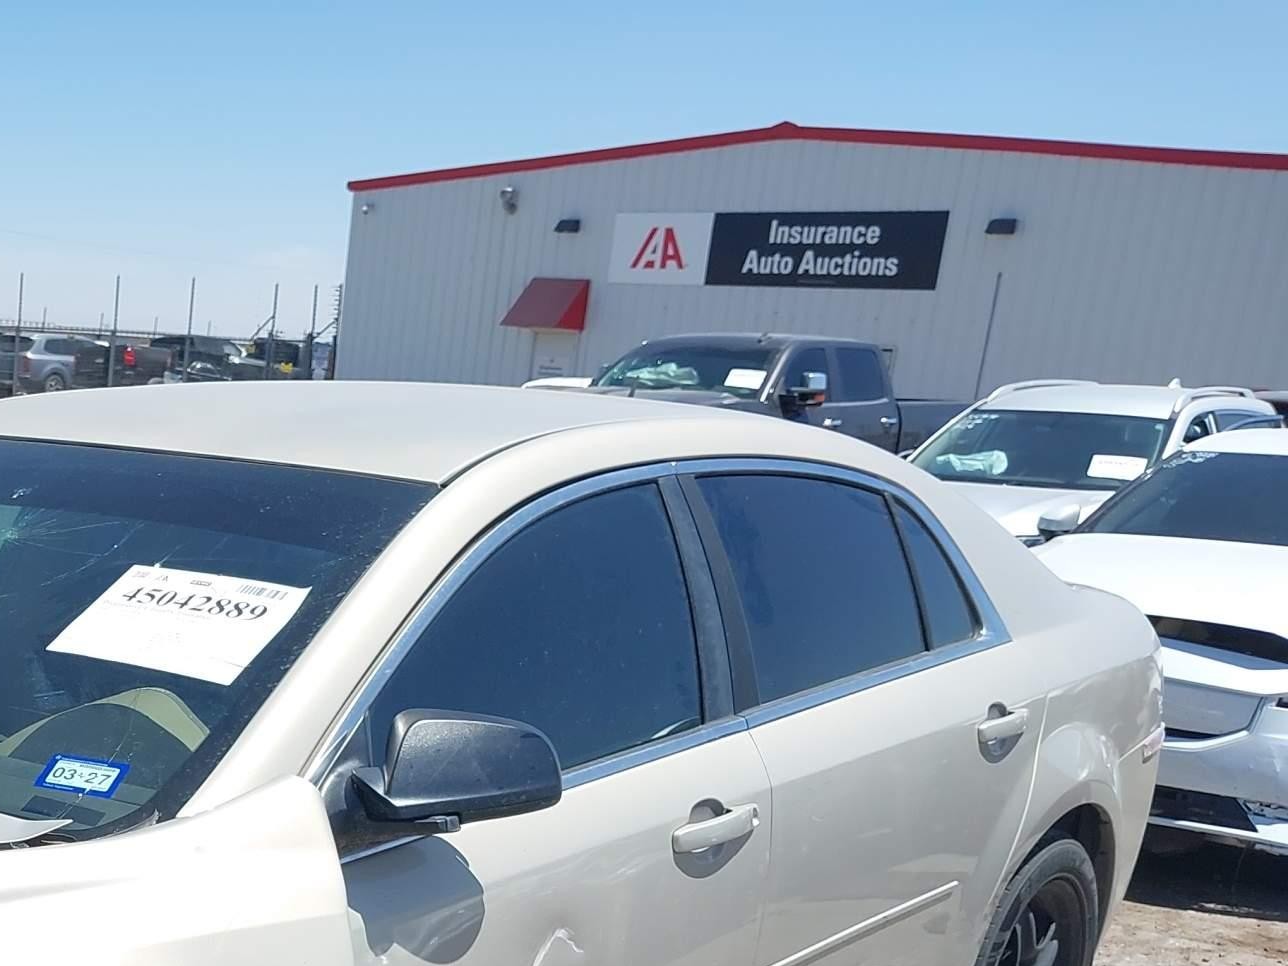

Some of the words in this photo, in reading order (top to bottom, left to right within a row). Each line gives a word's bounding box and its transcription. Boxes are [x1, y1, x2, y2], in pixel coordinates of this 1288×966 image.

[768, 219, 881, 245] Insurance
[741, 249, 793, 275] Auto
[797, 250, 899, 277] Auctions
[122, 587, 268, 621] 45042889
